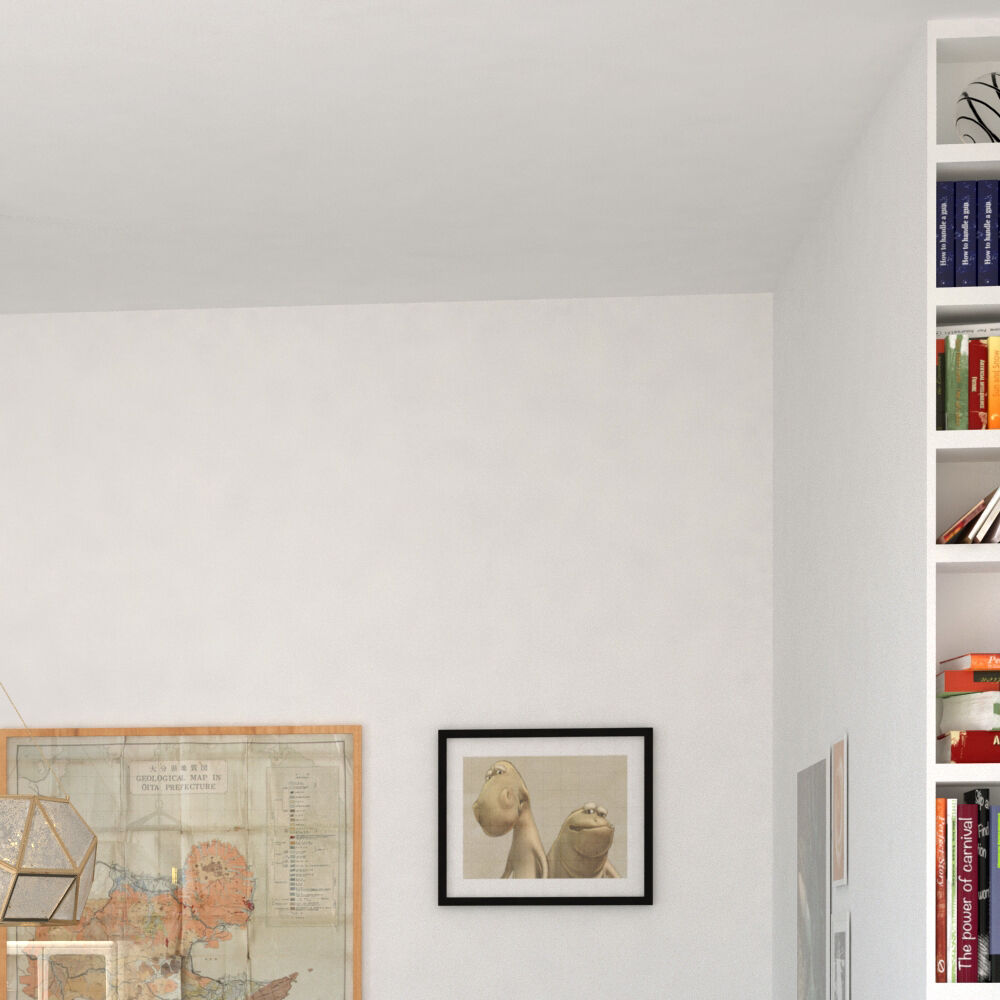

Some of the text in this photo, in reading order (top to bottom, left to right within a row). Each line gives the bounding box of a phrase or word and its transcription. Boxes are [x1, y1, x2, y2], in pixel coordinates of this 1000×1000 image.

[936, 856, 945, 887] Story
[958, 817, 976, 971] The power of carnival
